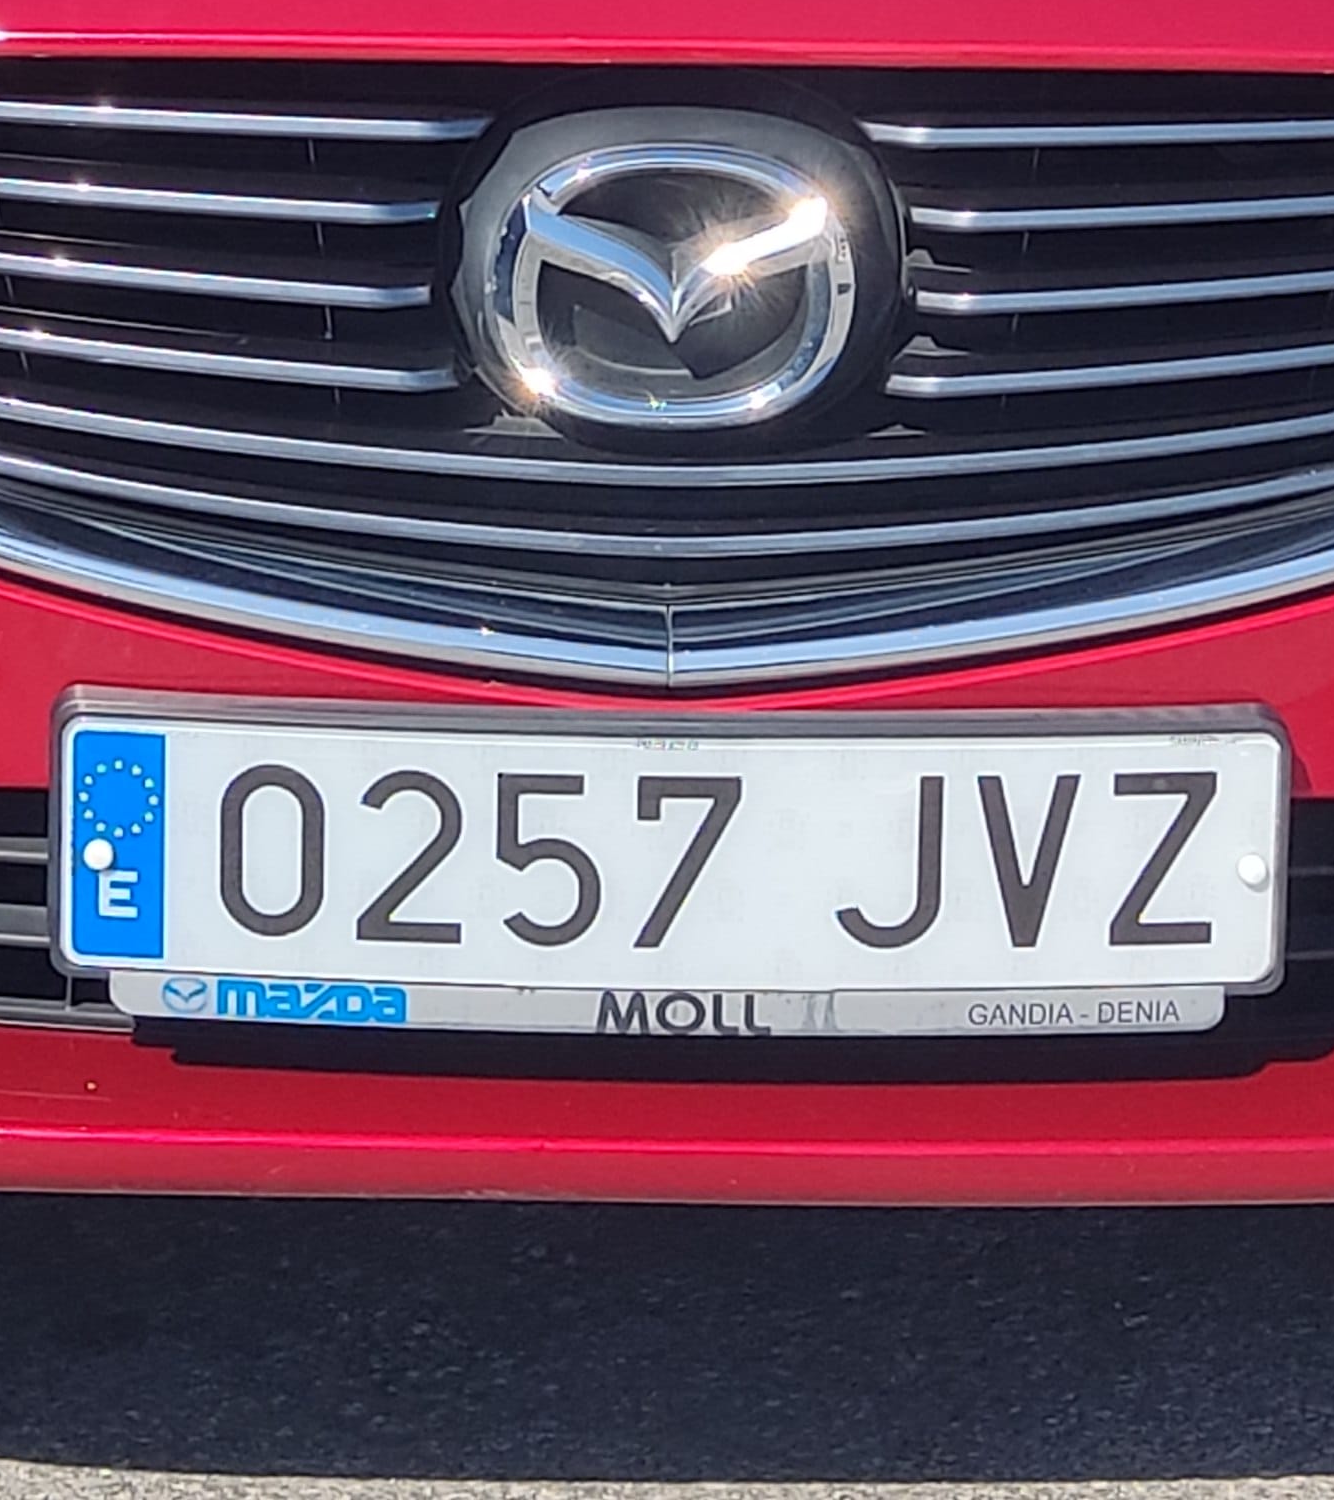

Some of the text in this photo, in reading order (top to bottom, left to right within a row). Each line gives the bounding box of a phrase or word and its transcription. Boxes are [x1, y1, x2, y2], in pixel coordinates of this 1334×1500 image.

[219, 763, 1220, 949] 0257 JVZ
[98, 869, 139, 919] E
[596, 990, 773, 1036] MOLL
[968, 1003, 1074, 1025] GANDIA
[1097, 1000, 1180, 1024] DENIA
